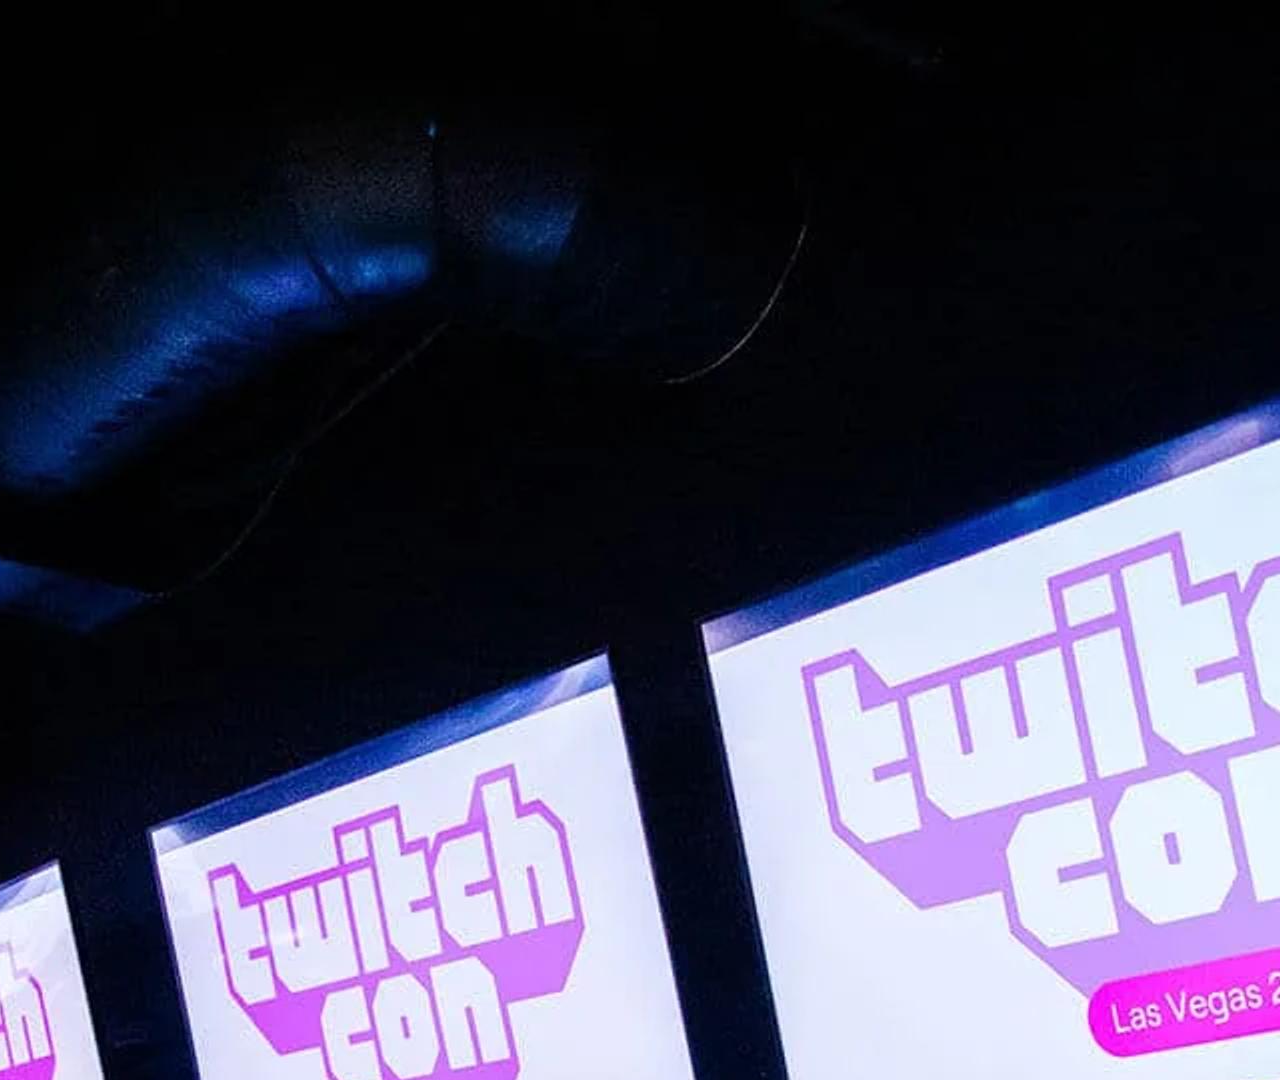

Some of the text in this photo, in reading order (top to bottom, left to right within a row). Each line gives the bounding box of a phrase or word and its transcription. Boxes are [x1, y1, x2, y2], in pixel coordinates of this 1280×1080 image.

[209, 776, 578, 1006] twitch
[1110, 1001, 1162, 1035] Las
[1164, 981, 1264, 1025] Vegas
